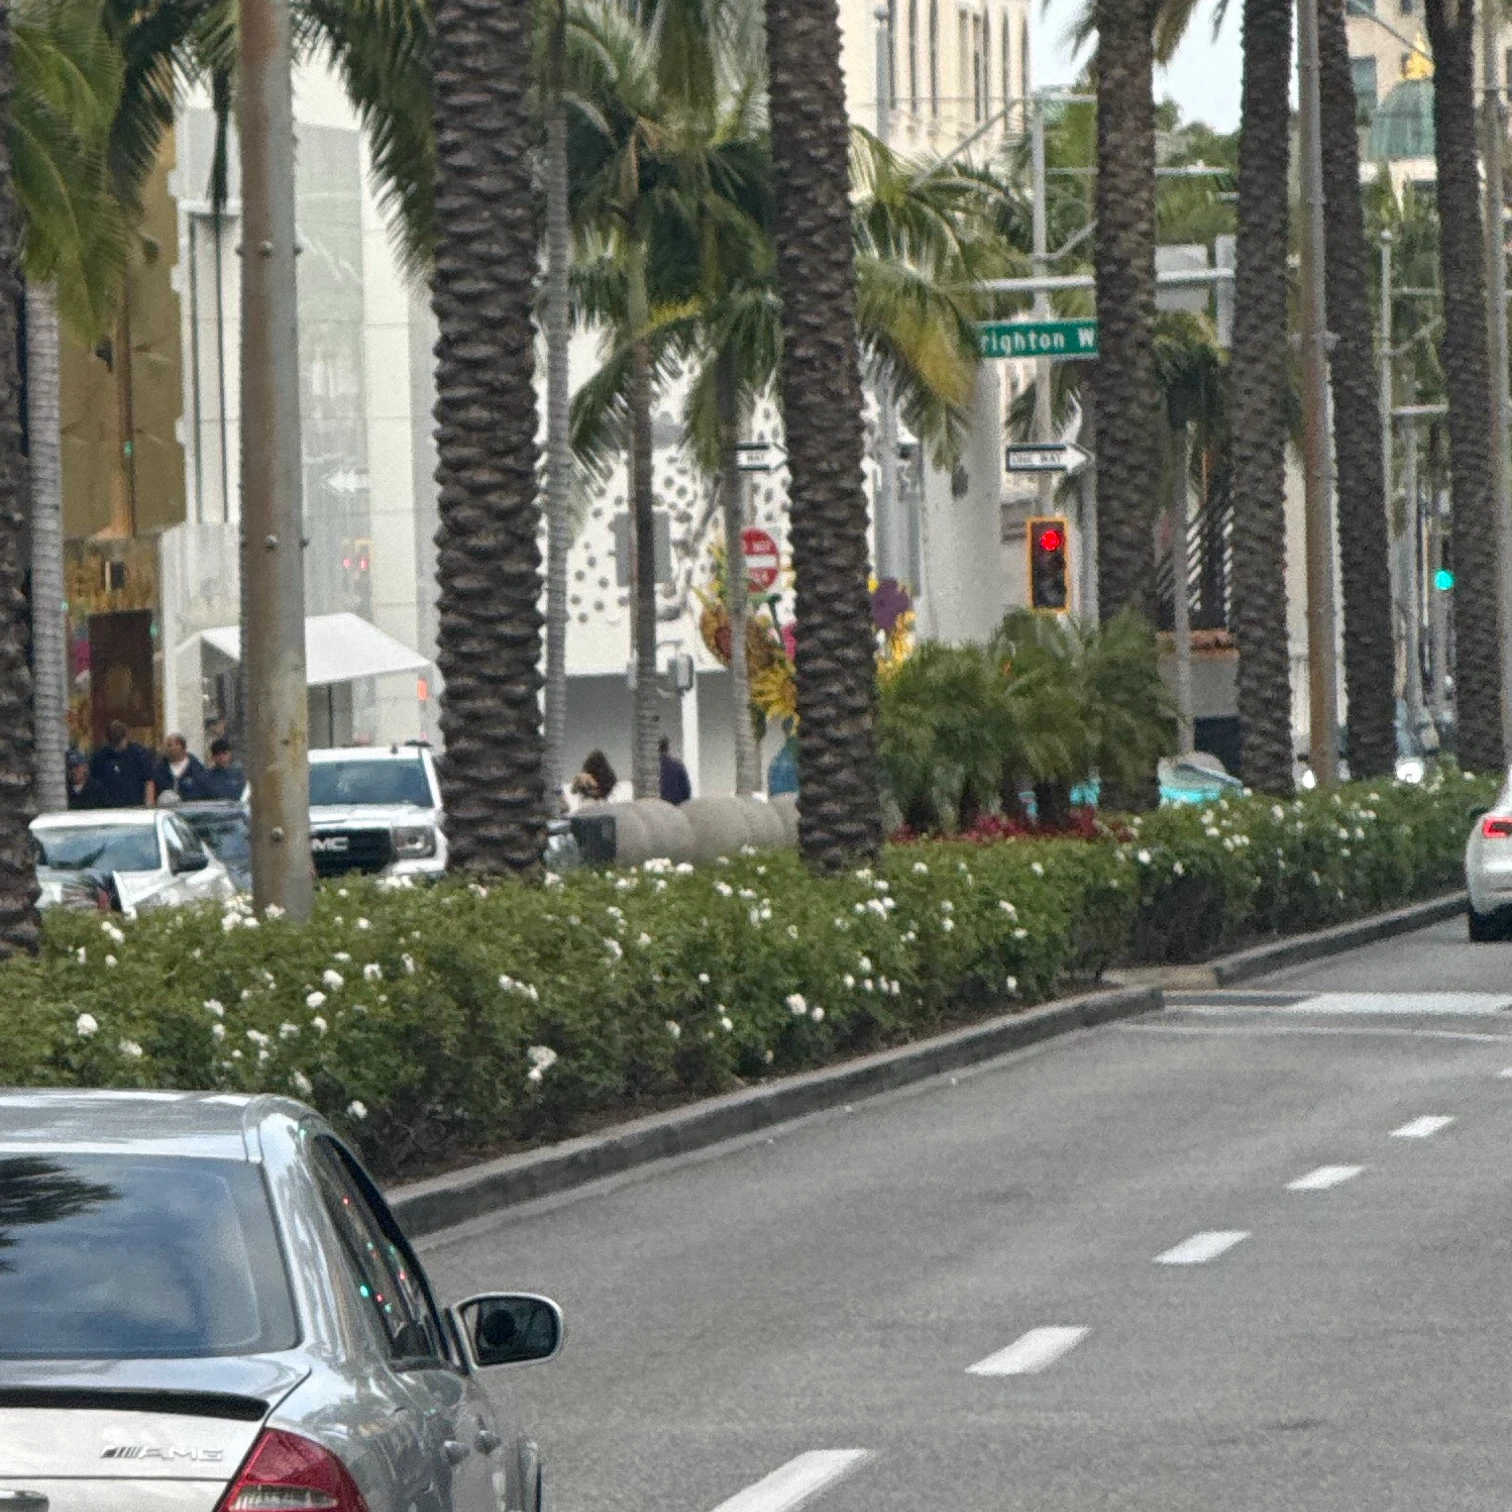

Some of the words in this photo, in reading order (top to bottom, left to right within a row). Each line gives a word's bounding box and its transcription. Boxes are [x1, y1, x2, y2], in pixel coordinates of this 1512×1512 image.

[980, 330, 1065, 356] righton
[311, 837, 349, 851] MC
[138, 1446, 224, 1461] AMG
